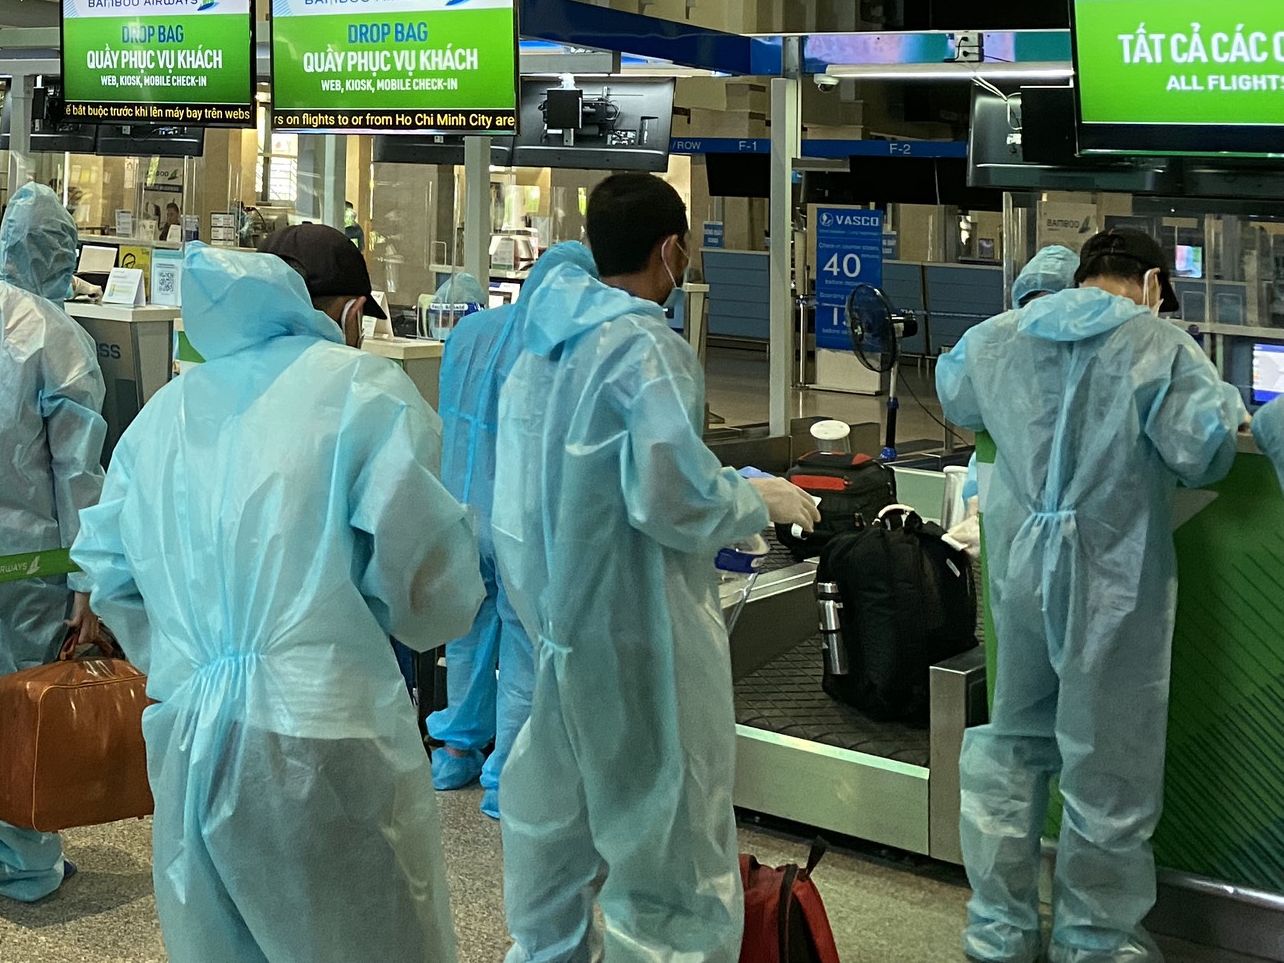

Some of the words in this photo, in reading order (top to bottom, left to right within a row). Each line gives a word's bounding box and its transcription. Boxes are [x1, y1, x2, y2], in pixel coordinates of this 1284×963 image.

[122, 25, 156, 43] DROP
[158, 24, 184, 43] BAG
[347, 22, 391, 44] DROP
[394, 22, 428, 43] BAG
[1117, 22, 1165, 64] TẤT
[1170, 22, 1208, 64] CẢ
[1211, 23, 1267, 64] CÁC
[86, 43, 120, 69] QUẦY
[121, 50, 156, 74] PHỤC
[157, 49, 174, 74] VỤ
[177, 44, 223, 69] KHÁCH
[303, 44, 346, 73] QUẦY
[347, 50, 391, 77] PHỤC
[393, 49, 416, 76] VỤ
[419, 43, 478, 71] KHÁCH
[100, 75, 119, 88] WEB,
[119, 75, 143, 88] KIOSK,
[144, 75, 171, 87] MOBILE
[171, 75, 207, 87] CHECK-IN
[321, 79, 344, 93] WEB,
[345, 79, 375, 93] KIOSK,
[376, 78, 411, 91] MOBILE
[412, 78, 458, 91] CHECK-IN
[1166, 75, 1204, 91] ALL
[87, 105, 109, 118] buộc
[110, 105, 134, 117] trước
[134, 105, 148, 117] khi
[149, 105, 163, 118] lên
[165, 106, 185, 121] máy
[186, 106, 203, 121] bay
[204, 107, 223, 119] trên
[286, 115, 300, 126] on
[302, 112, 335, 128] flights
[337, 114, 349, 126] to
[351, 115, 363, 126] or
[365, 113, 392, 126] from
[395, 114, 412, 126] Ho
[414, 113, 433, 126] Chi
[436, 113, 466, 126] Minh
[468, 113, 493, 129] City
[495, 116, 515, 127] are
[739, 141, 757, 151] F-1
[889, 143, 911, 155] F-2
[835, 215, 879, 227] VASCO
[1046, 218, 1080, 229] BAMBOO
[823, 252, 861, 278] 40
